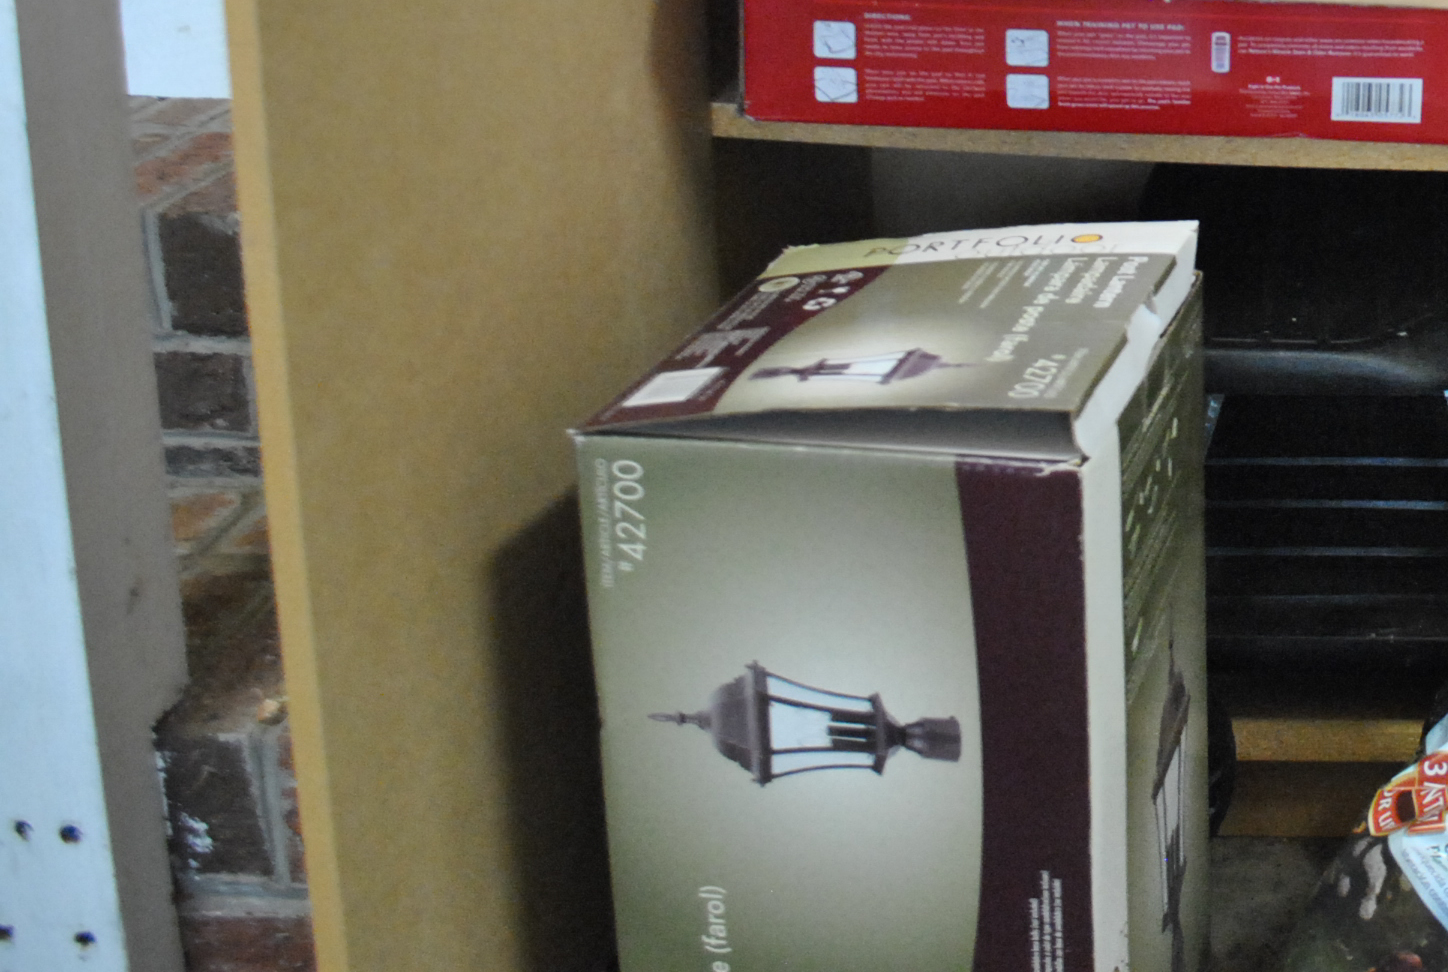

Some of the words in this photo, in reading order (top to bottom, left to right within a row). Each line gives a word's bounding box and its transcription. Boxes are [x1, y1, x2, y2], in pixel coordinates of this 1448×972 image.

[863, 232, 1103, 258] PORTFOLIO
[1422, 760, 1448, 776] 3
[698, 884, 733, 954] (farol)
